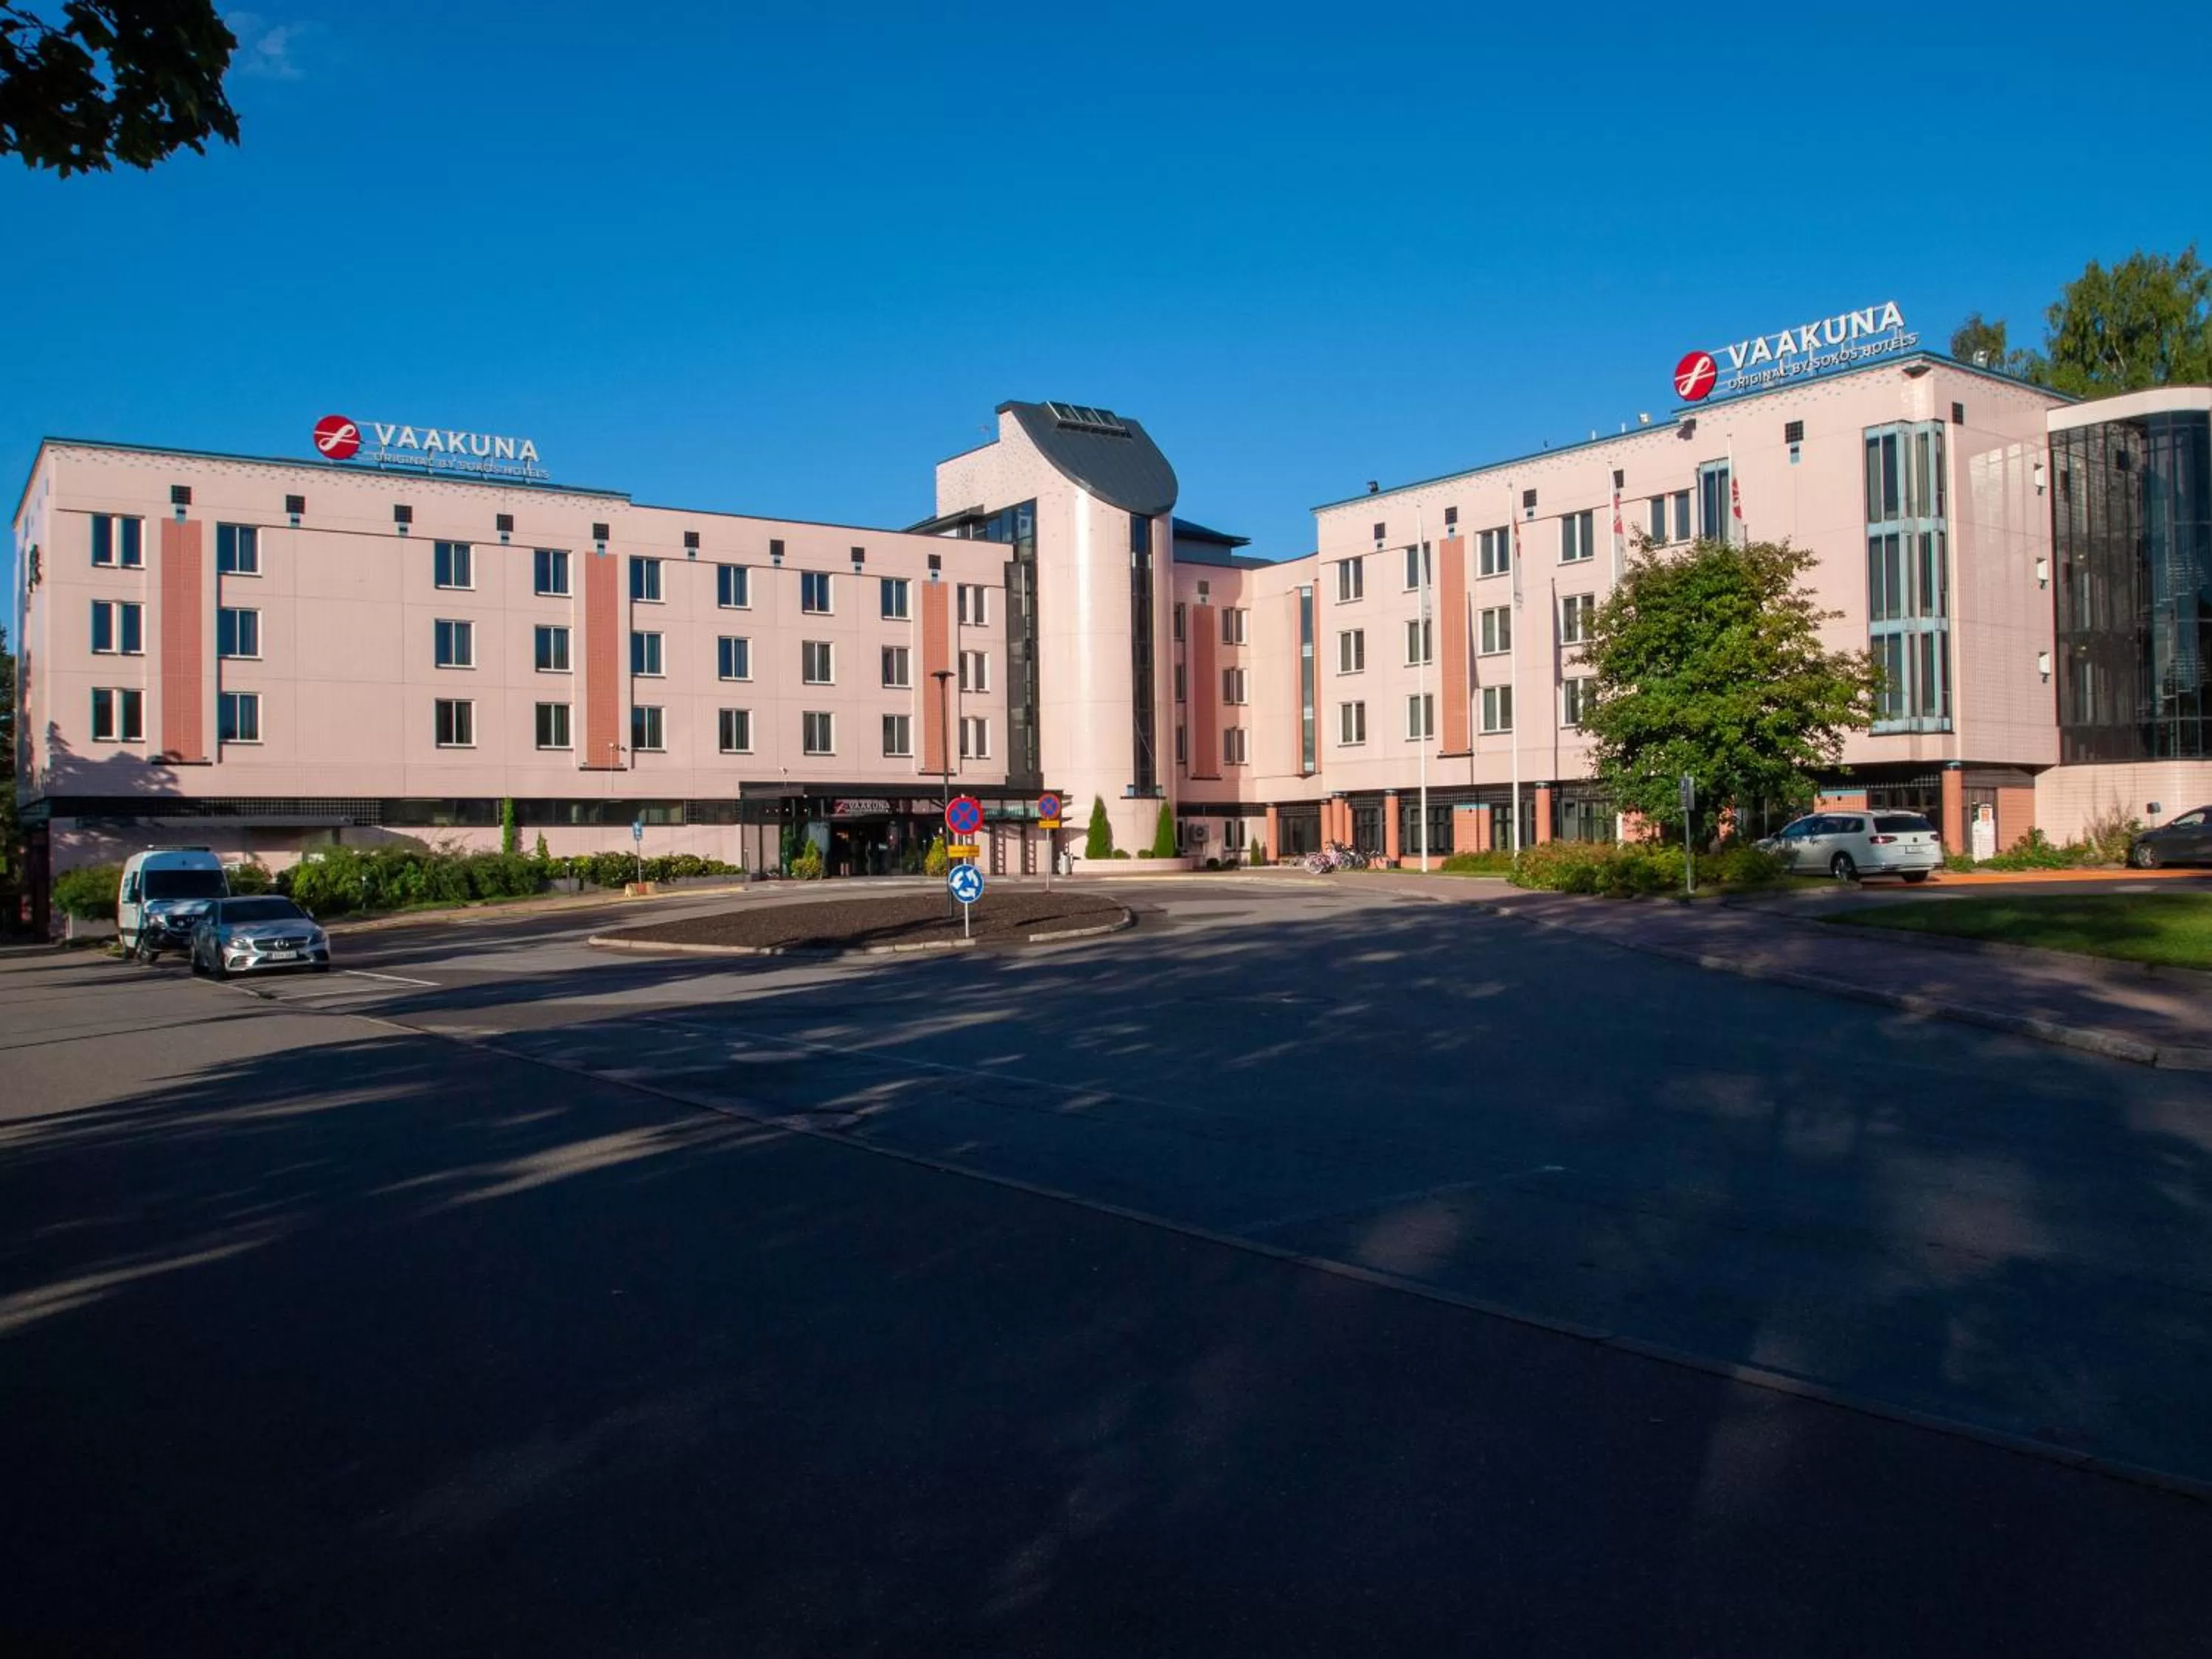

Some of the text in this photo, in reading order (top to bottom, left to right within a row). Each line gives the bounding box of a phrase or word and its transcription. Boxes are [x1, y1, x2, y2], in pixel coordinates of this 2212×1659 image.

[1728, 301, 1905, 369] VAAKUNA
[1728, 333, 1917, 390] ORIGINAL BY SOKOS HOTELS
[374, 422, 539, 462] VAAKUNA
[849, 801, 890, 809] VAAKUNA
